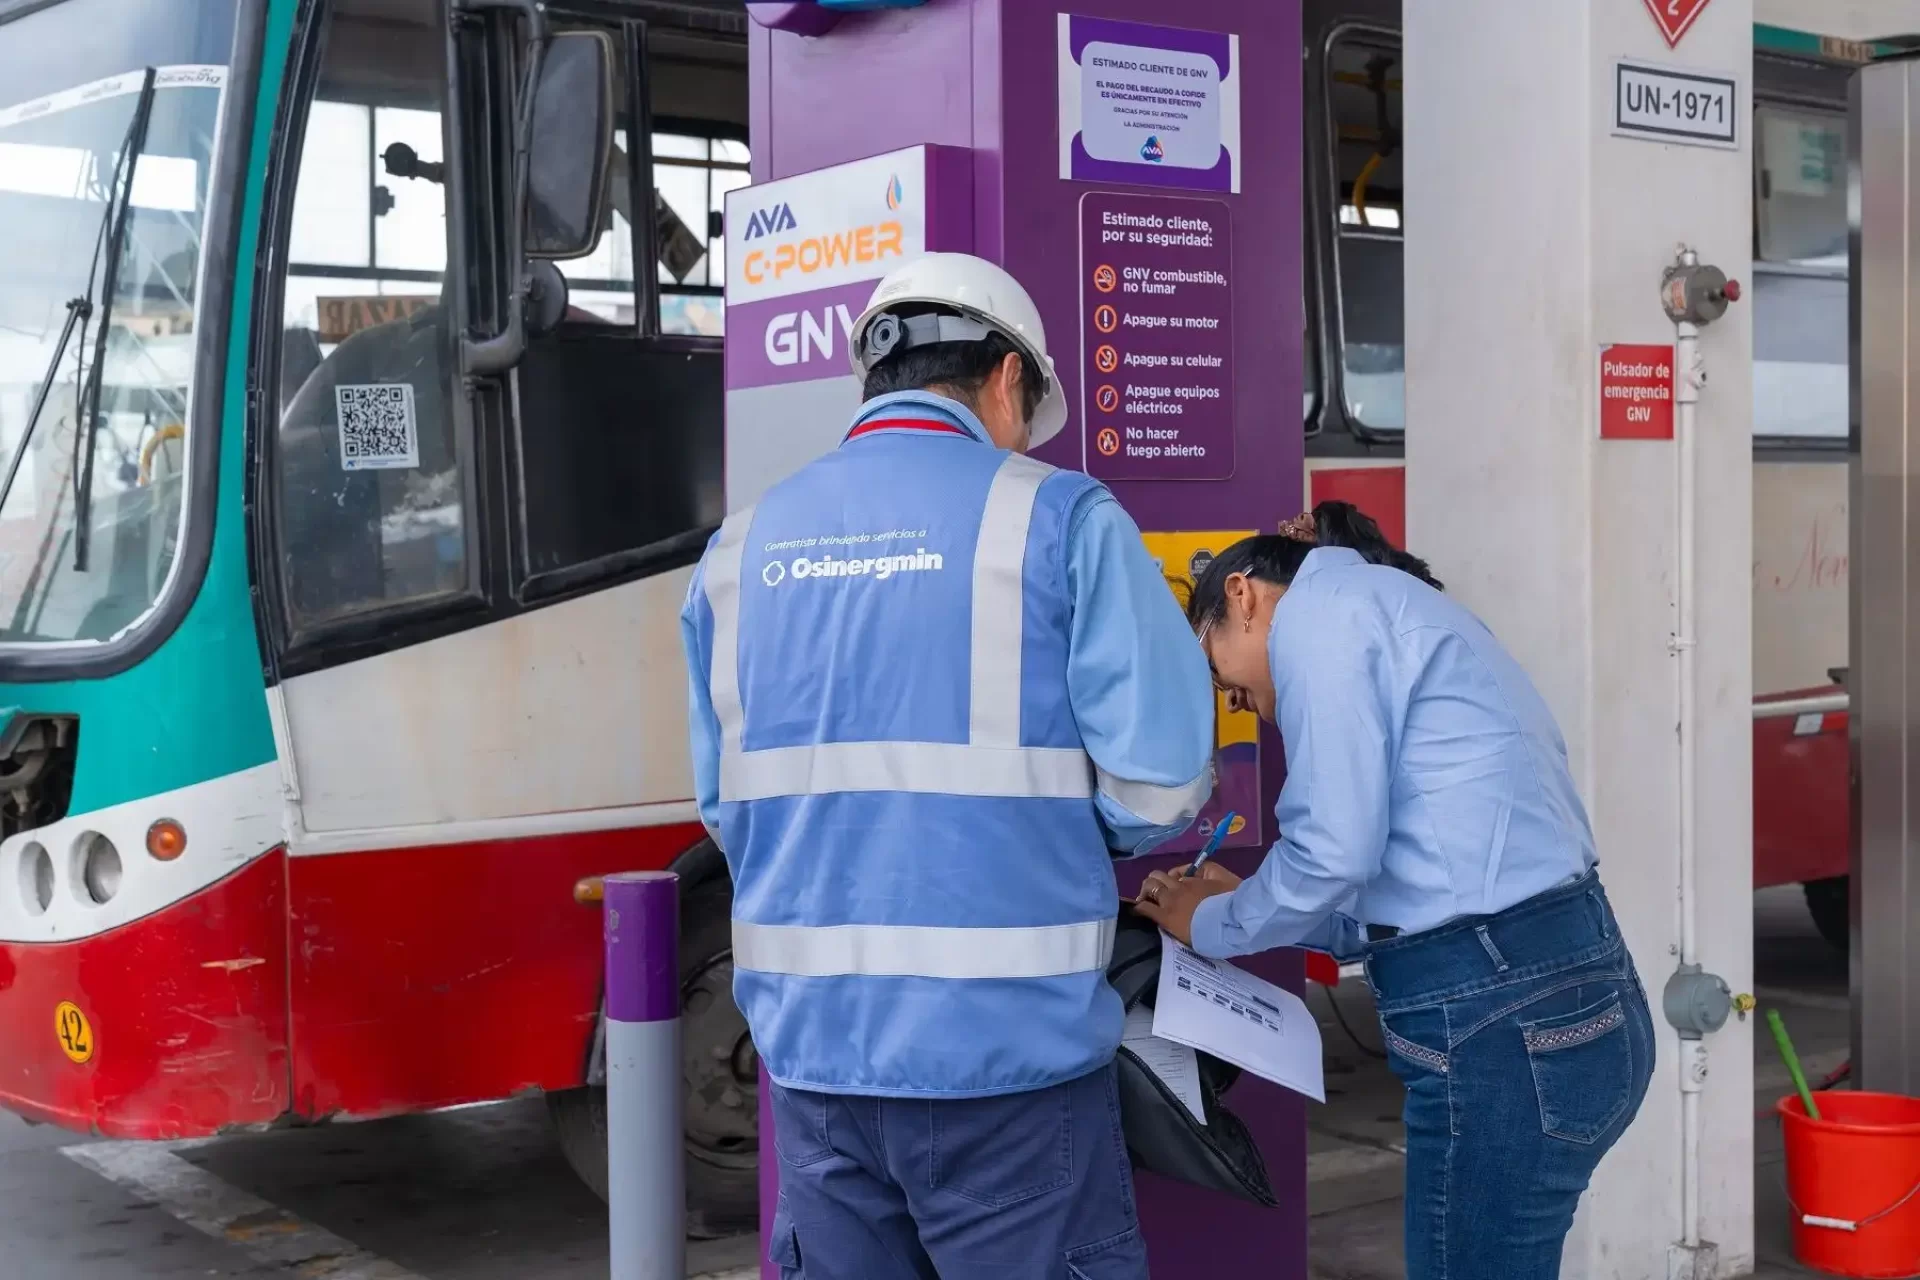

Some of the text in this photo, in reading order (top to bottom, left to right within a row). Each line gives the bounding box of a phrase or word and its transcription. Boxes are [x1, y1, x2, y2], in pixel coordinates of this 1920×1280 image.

[1092, 57, 1208, 78] ESTIMADO CLIENTE DE GNV
[1105, 82, 1125, 90] PAGO
[1126, 84, 1139, 92] DEL
[1140, 85, 1174, 95] RECAUDO
[1181, 89, 1206, 99] COFIDE
[1111, 90, 1156, 103] ÚNICAMENTE
[1168, 98, 1202, 108] EFECTIVO
[1113, 107, 1138, 115] GRACIAS
[1626, 82, 1723, 124] UN-1971
[744, 202, 797, 241] AVA
[1103, 211, 1212, 233] Estimado cliente,
[1102, 229, 1213, 247] por su seguridad:
[1123, 267, 1227, 286] GNV combustible,
[1123, 281, 1176, 294] no fumar
[1123, 312, 1219, 329] Apague su motor
[1123, 352, 1222, 368] Apague su celular
[1603, 361, 1670, 378] Pulsador de
[1125, 384, 1220, 400] Apague equipos
[1604, 384, 1670, 402] emergencia
[1125, 401, 1183, 414] eléctricos
[1626, 405, 1651, 422] GNV
[1126, 427, 1179, 439] No hacer
[1126, 443, 1205, 459] fuego abierto
[765, 528, 928, 552] Contratista brindando servicios a
[791, 548, 943, 579] Osinergmin
[61, 1010, 86, 1052] 42
